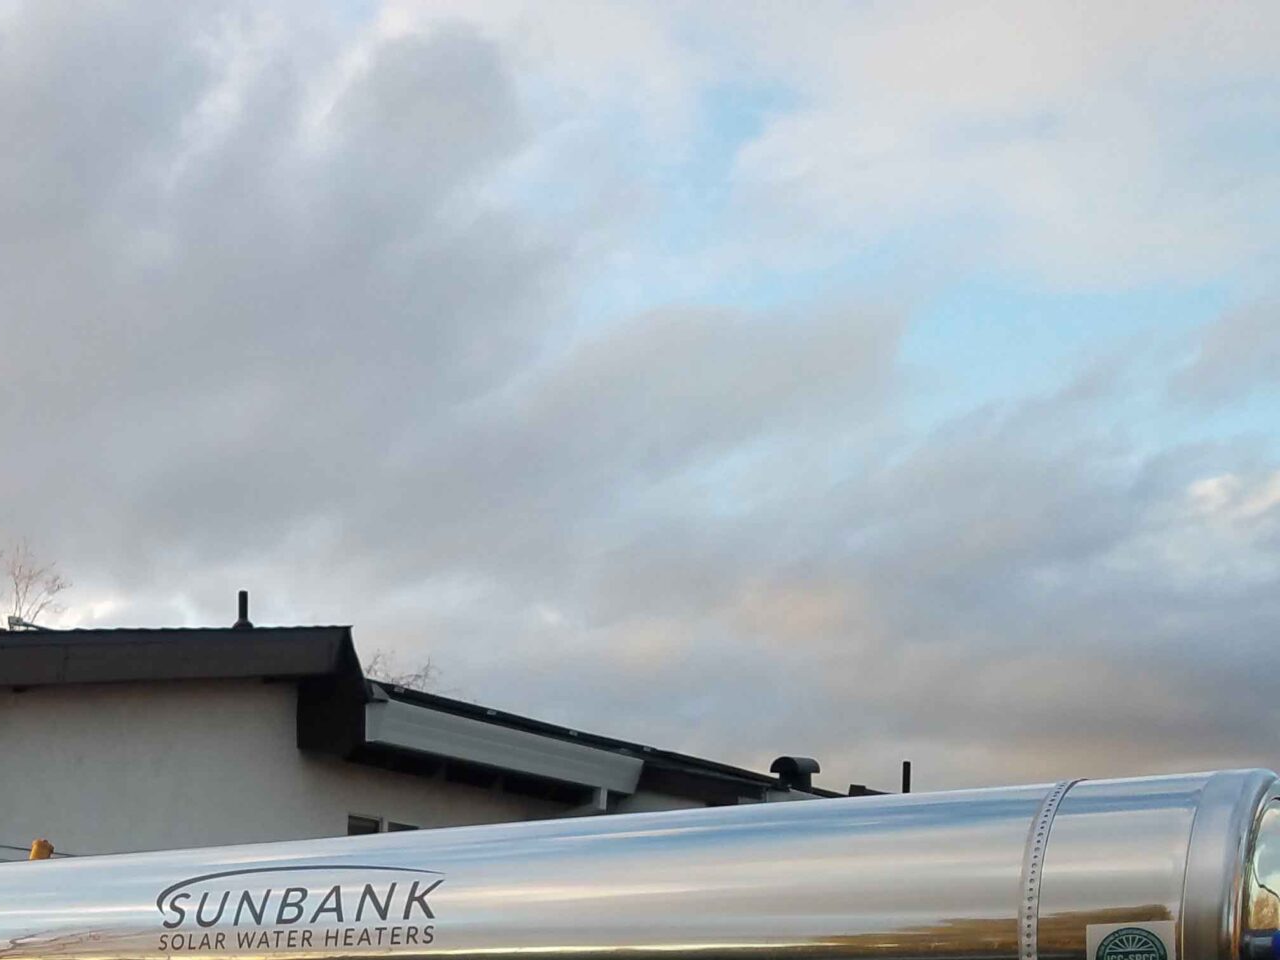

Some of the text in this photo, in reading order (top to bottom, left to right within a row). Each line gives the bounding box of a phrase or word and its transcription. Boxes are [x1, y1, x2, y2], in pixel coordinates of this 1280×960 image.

[162, 879, 446, 929] SUNBANK
[158, 925, 435, 951] SOLAR WATER HEATERS
